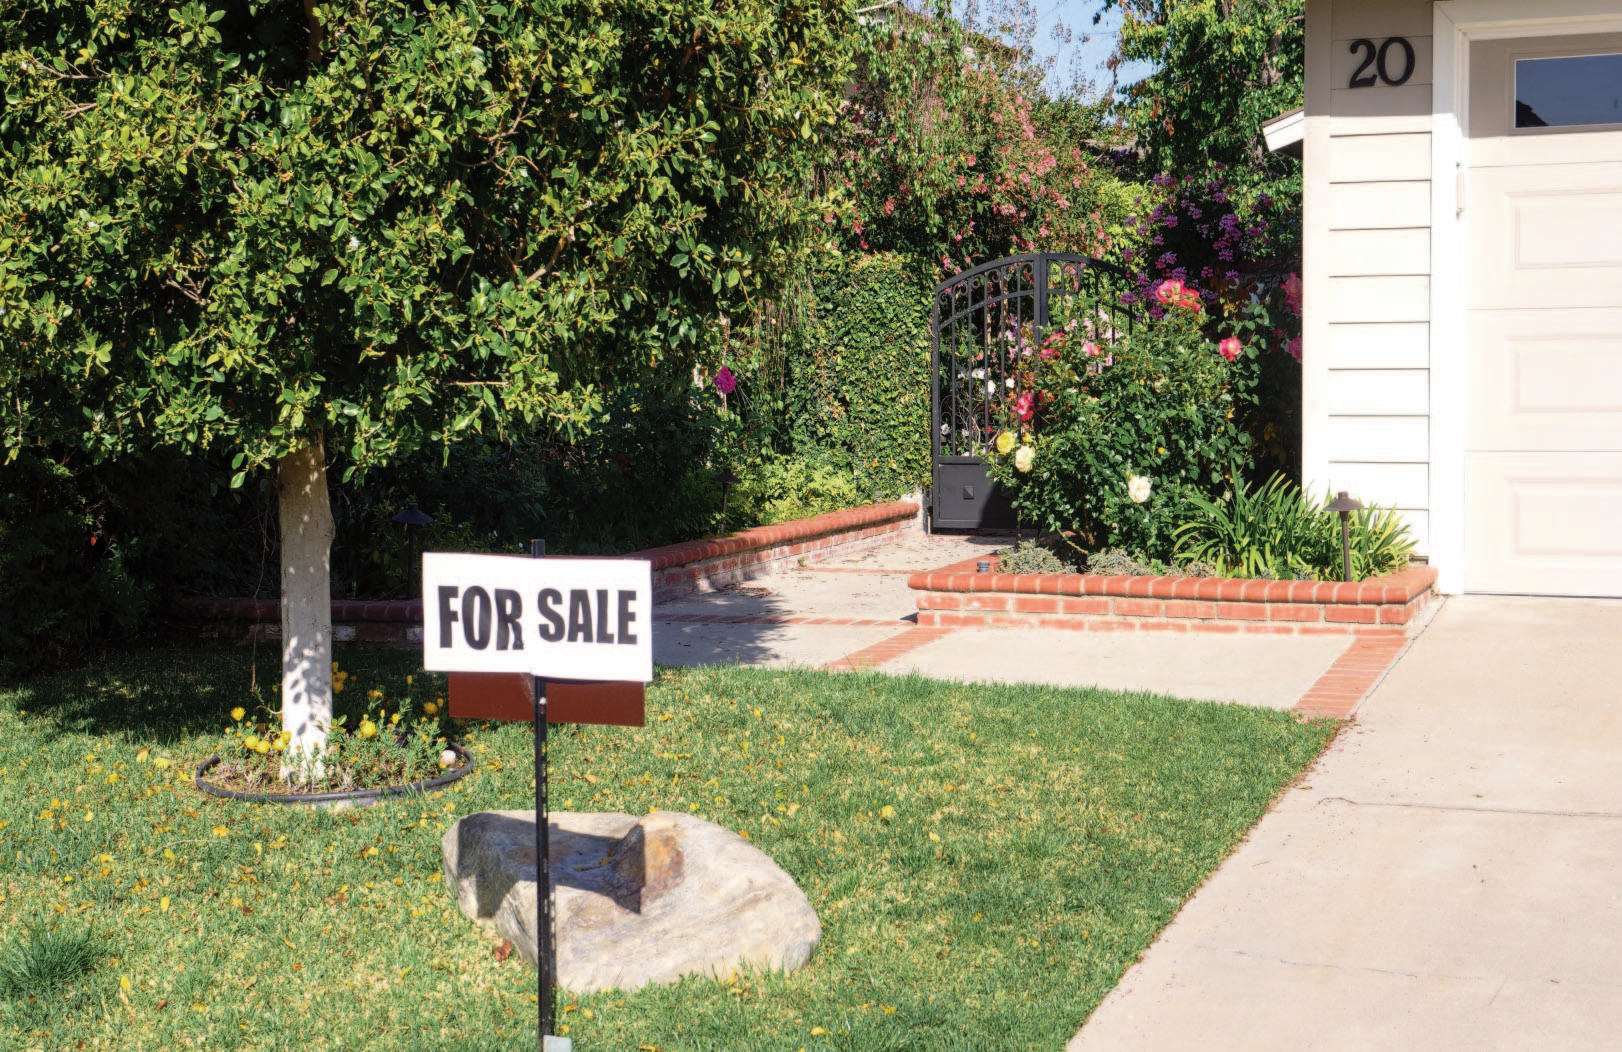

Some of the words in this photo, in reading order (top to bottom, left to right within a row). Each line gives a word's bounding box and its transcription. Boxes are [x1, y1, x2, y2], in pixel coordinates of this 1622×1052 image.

[1349, 36, 1416, 89] 20
[438, 585, 524, 651] FOR
[537, 587, 638, 645] SALE
